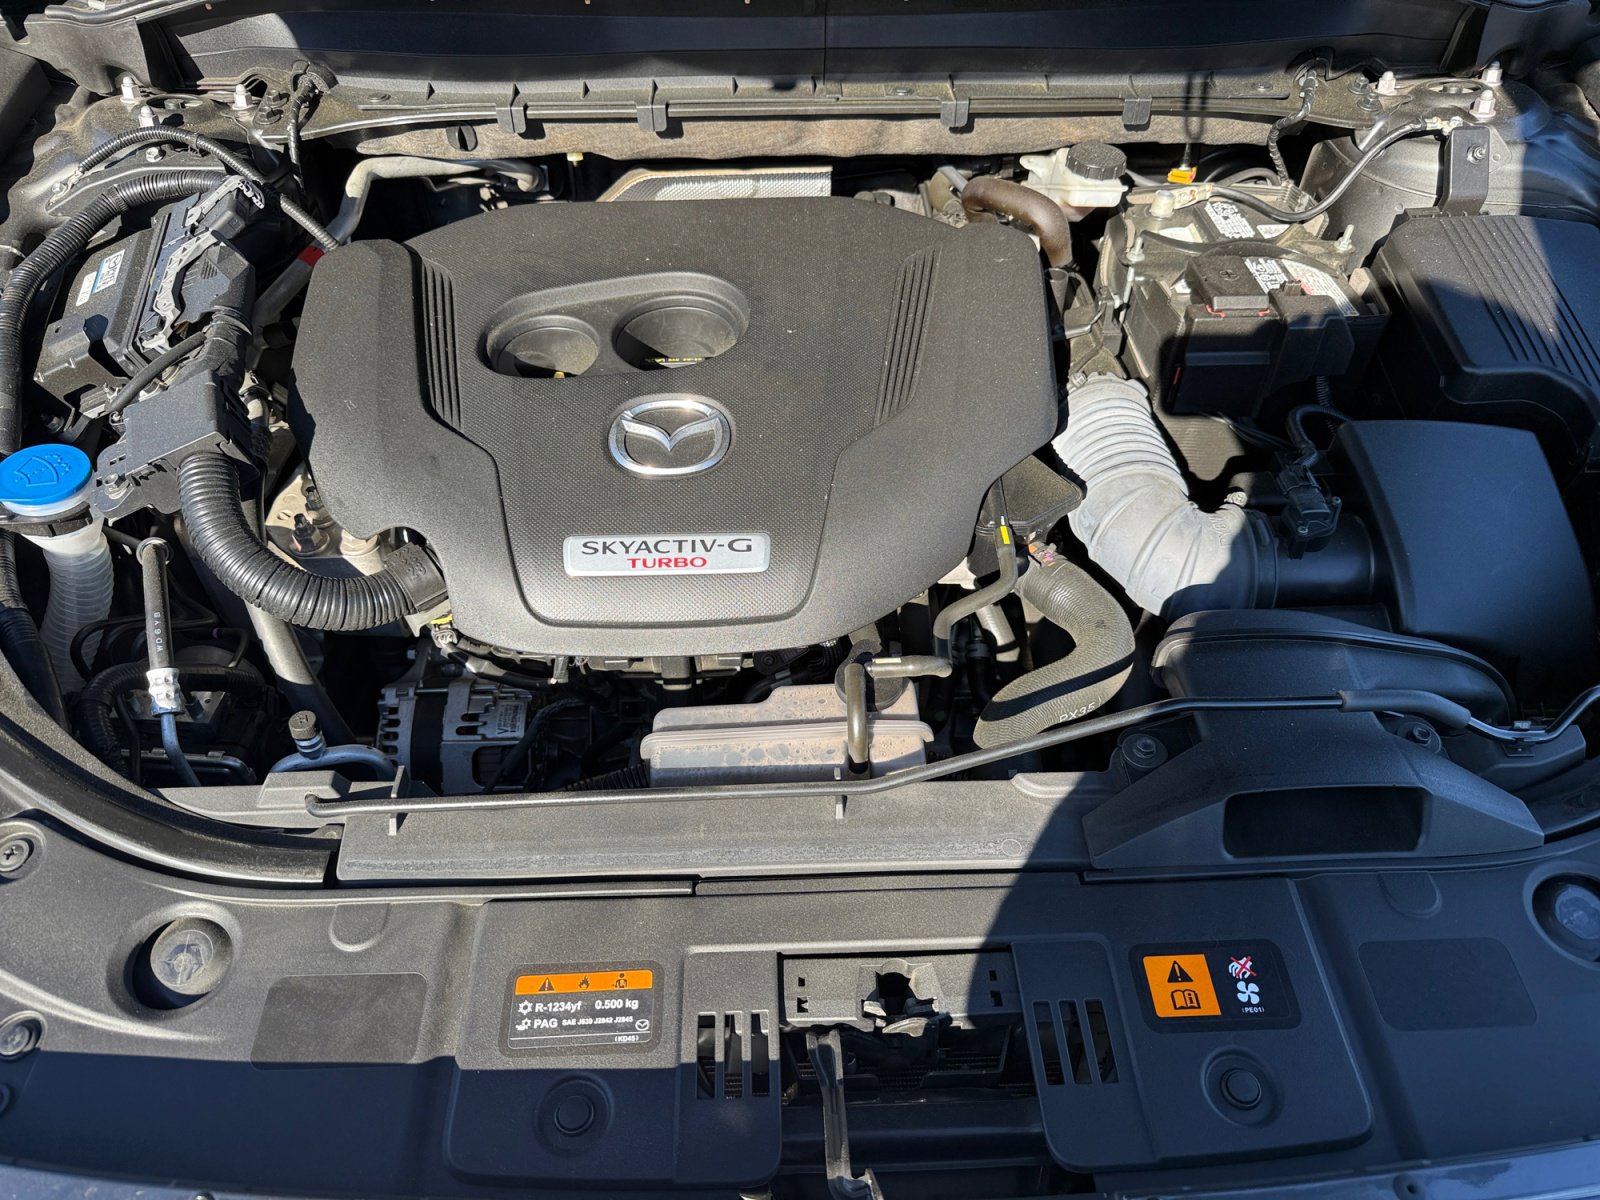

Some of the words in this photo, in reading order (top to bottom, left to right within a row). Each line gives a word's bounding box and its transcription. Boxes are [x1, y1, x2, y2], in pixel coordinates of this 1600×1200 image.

[581, 538, 753, 555] SKYACTIV-G
[627, 556, 707, 569] TURBO
[535, 1000, 582, 1013] R-1234yf
[595, 999, 624, 1010] 0.500
[625, 998, 639, 1010] kg
[533, 1018, 559, 1029] PAG
[561, 1018, 577, 1026] SAE
